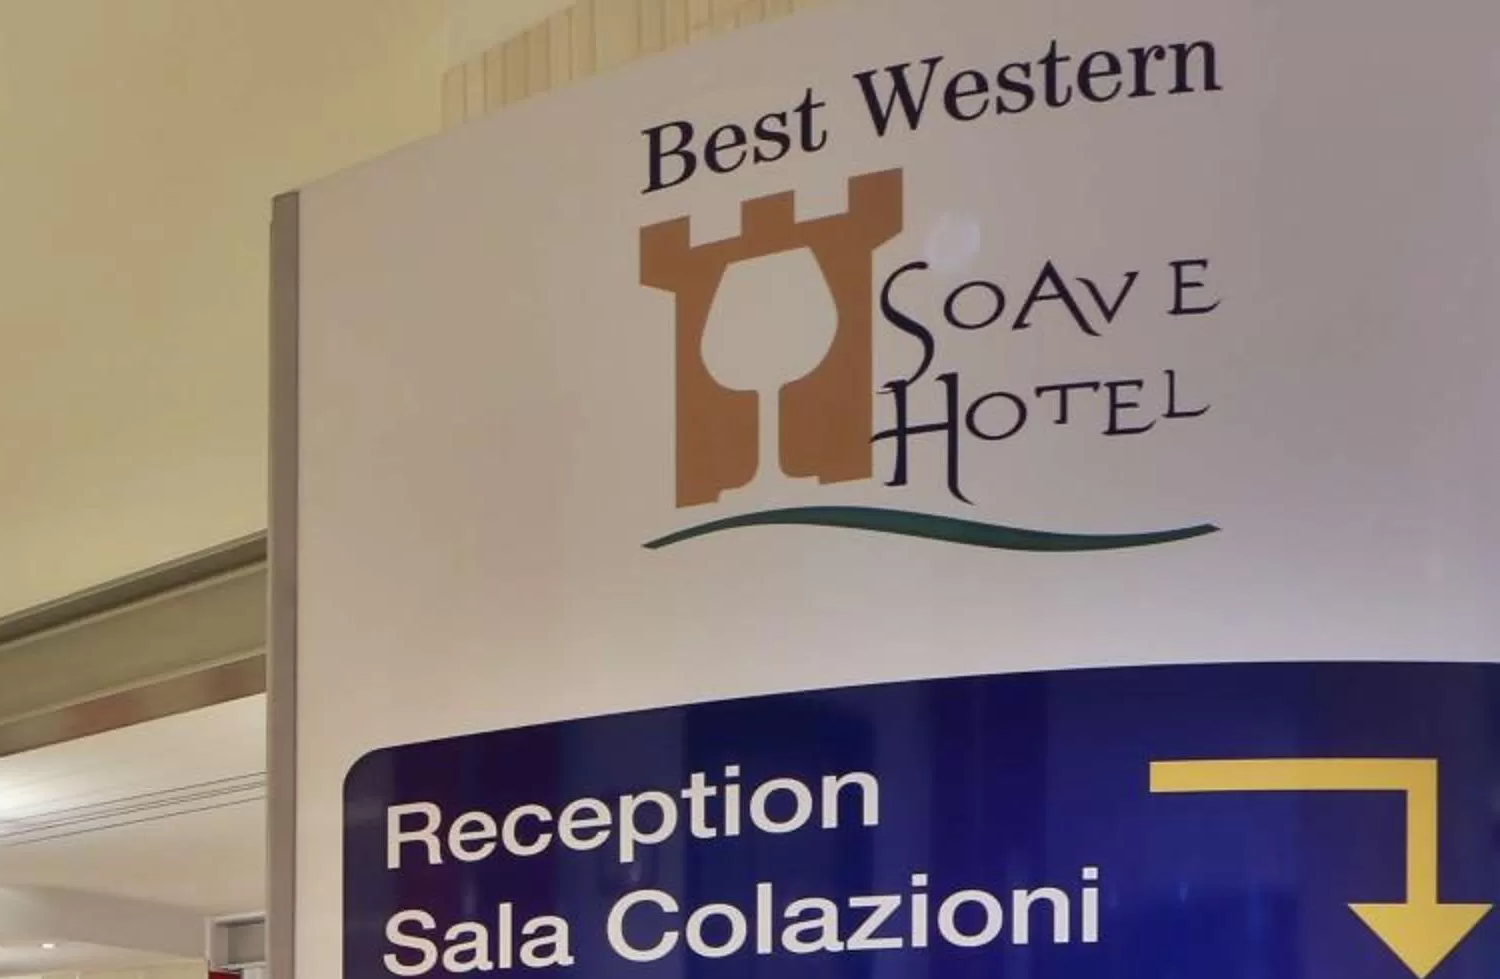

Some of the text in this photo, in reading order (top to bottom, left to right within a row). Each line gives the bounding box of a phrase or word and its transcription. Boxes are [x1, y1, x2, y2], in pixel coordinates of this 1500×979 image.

[641, 38, 1222, 196] Best Western
[386, 764, 880, 870] Reception
[382, 866, 1099, 977] Sala Colazioni
